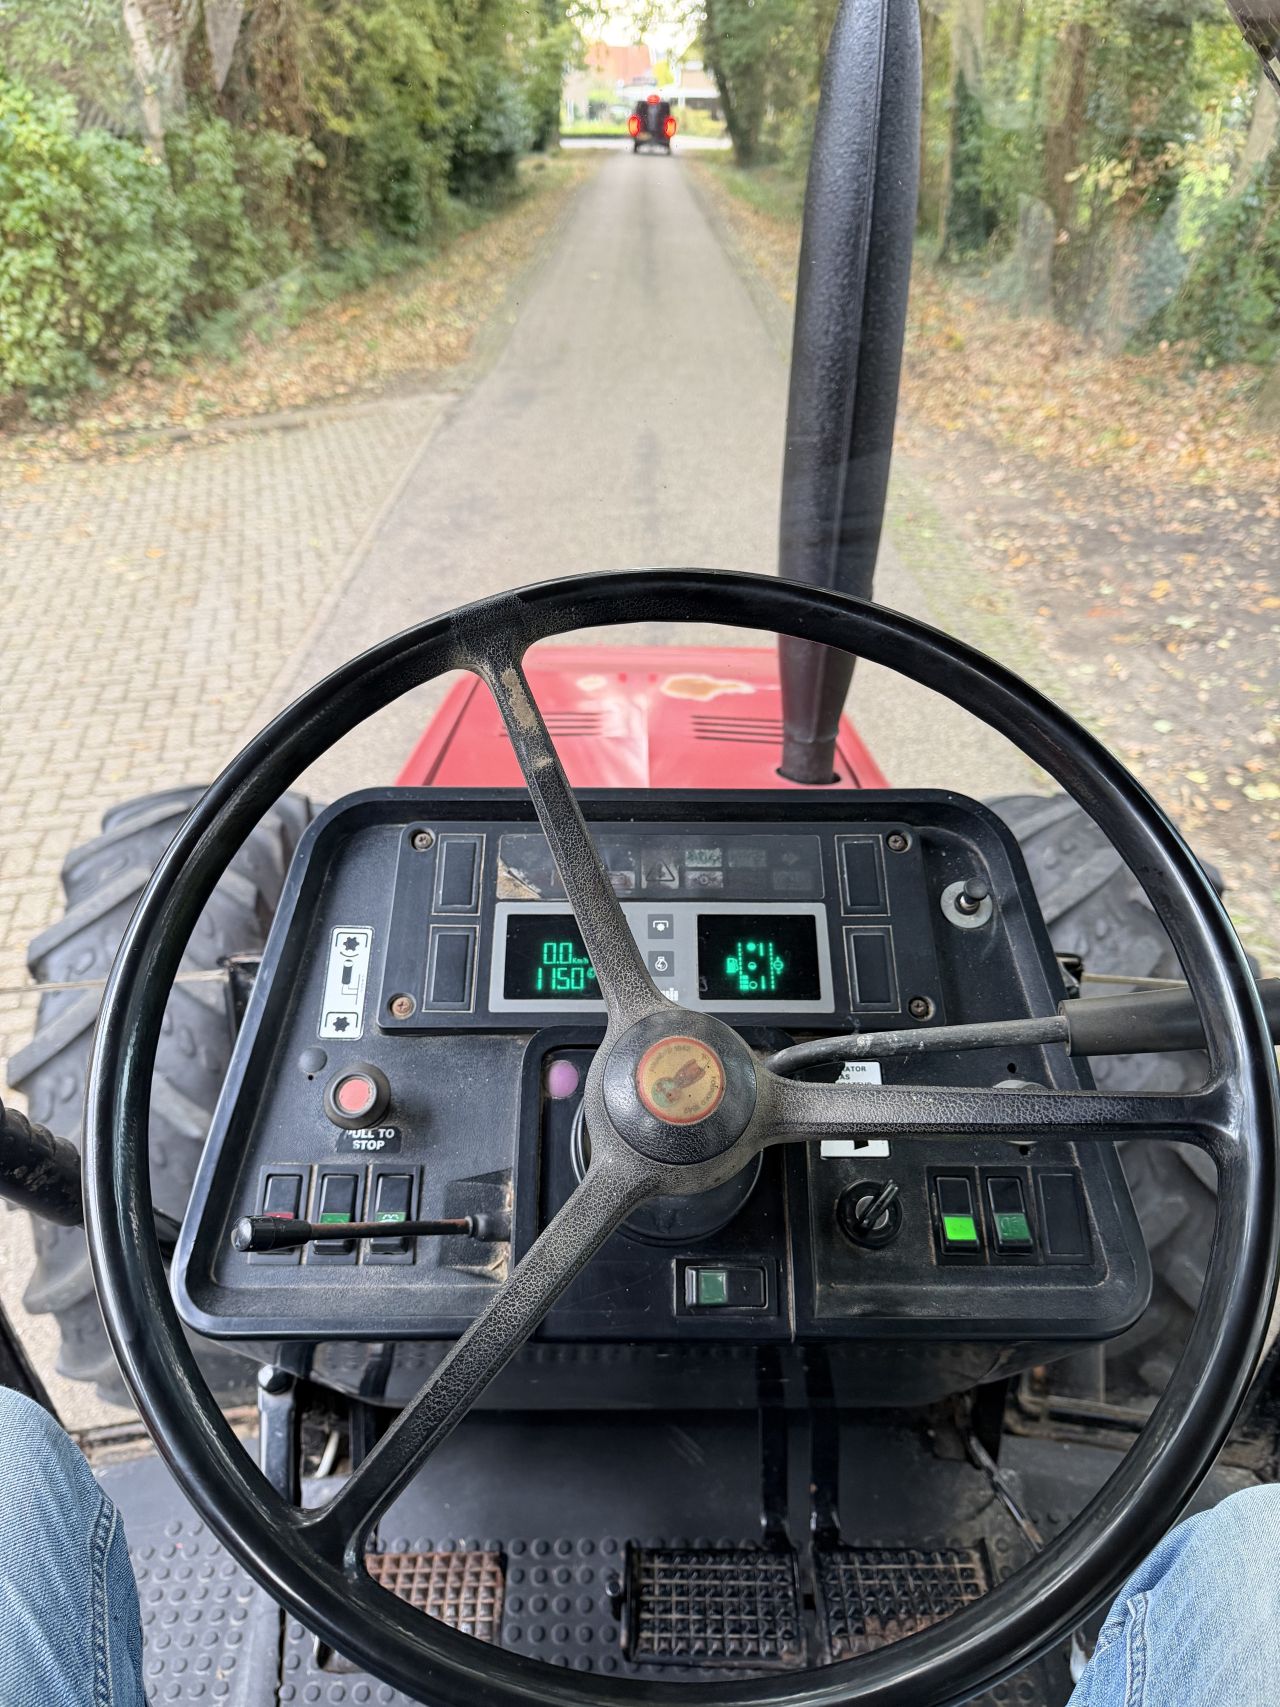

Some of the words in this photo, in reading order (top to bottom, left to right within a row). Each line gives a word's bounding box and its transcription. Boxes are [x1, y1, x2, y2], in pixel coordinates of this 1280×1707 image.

[543, 942, 573, 965] 0.0
[537, 967, 585, 990] 1150
[378, 1128, 395, 1139] TO
[352, 1139, 386, 1151] STOP
